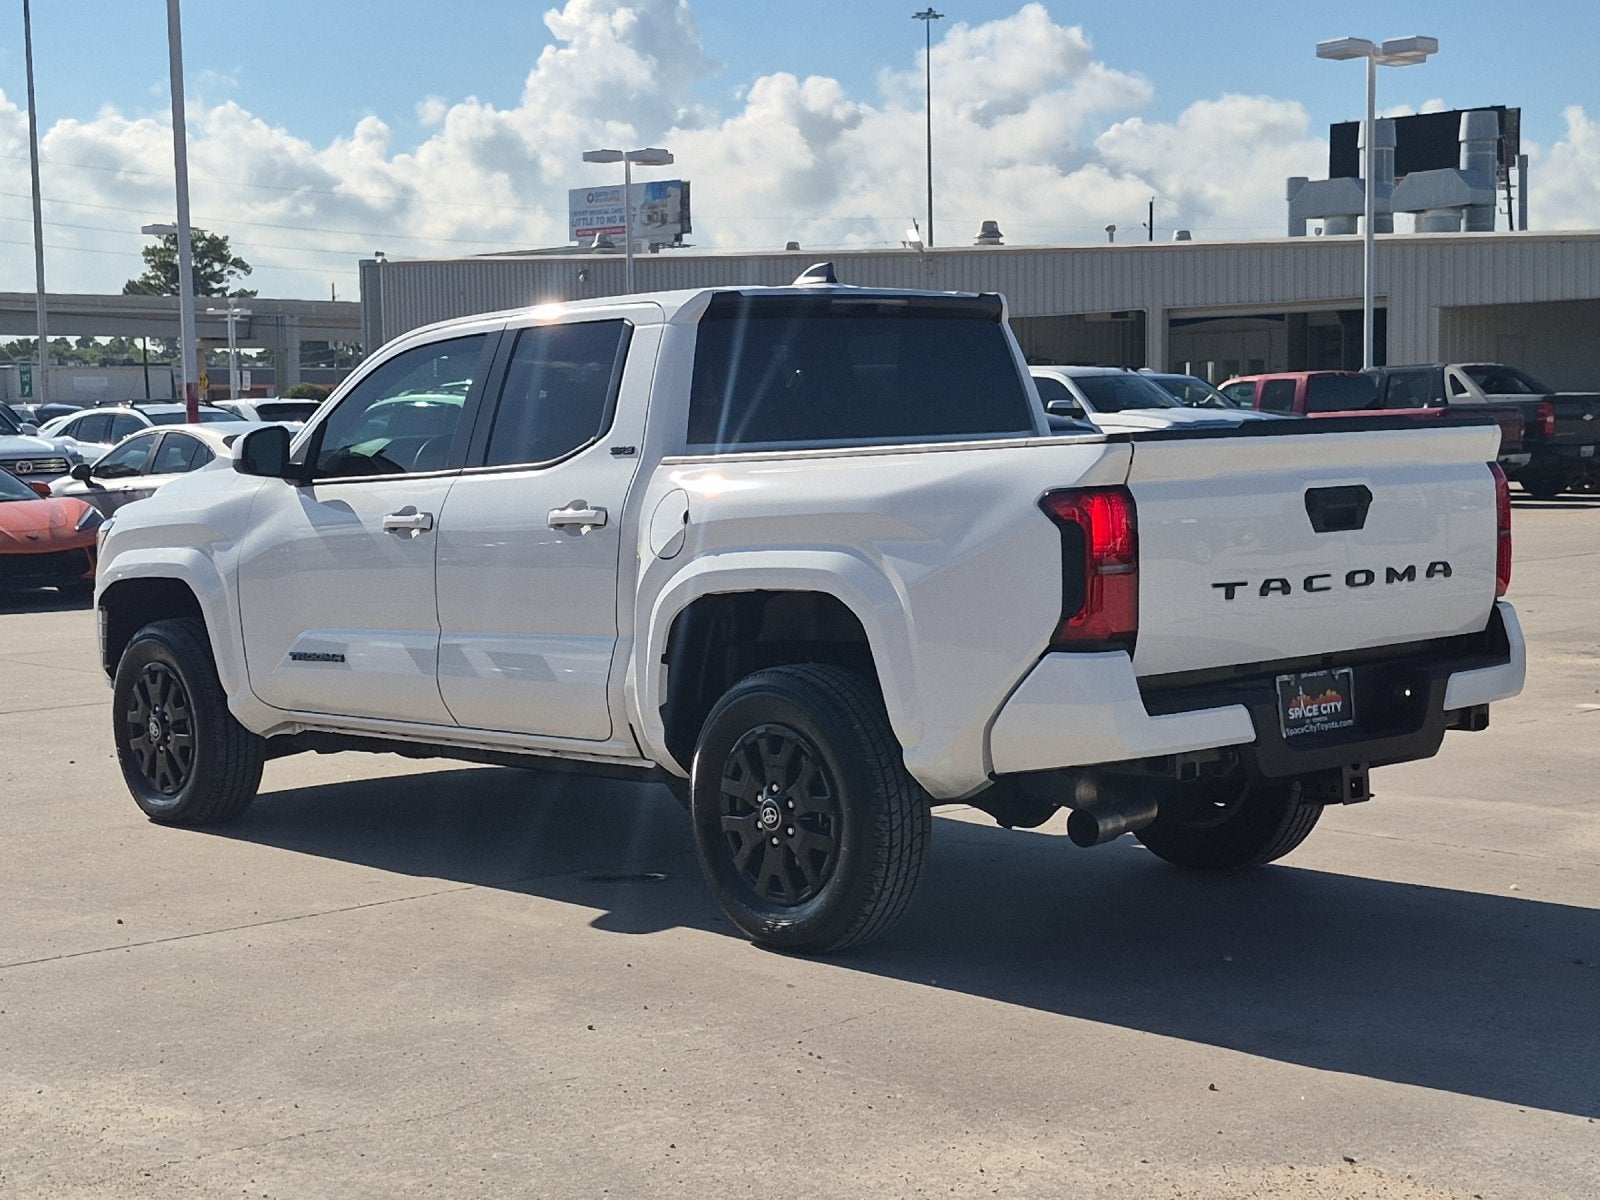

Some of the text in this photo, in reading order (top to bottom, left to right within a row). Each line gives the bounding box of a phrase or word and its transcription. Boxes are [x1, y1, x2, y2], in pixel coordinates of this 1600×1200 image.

[571, 216, 594, 227] LITTLE
[596, 216, 605, 225] TO
[606, 215, 617, 224] NO
[1211, 560, 1453, 601] TACOMA
[1288, 701, 1343, 720] SPACE CITY
[1286, 719, 1353, 737] SpaceCityToyota.com
